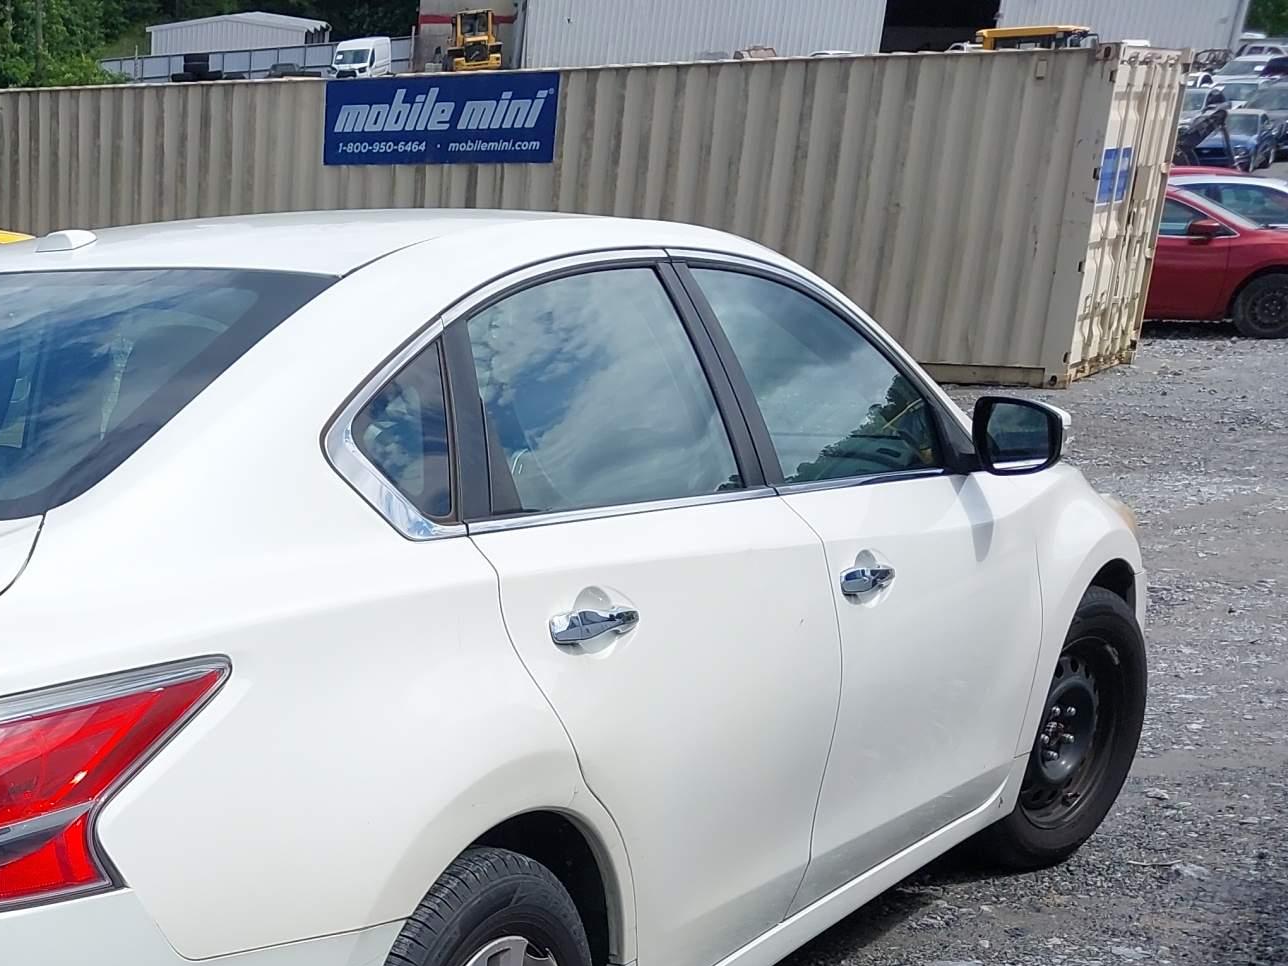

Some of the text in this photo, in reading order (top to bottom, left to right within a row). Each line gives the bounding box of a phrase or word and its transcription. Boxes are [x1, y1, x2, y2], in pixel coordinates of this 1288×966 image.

[334, 87, 549, 133] mobile mini
[338, 138, 540, 153] 1-800-950-6464 mobilemini.com
